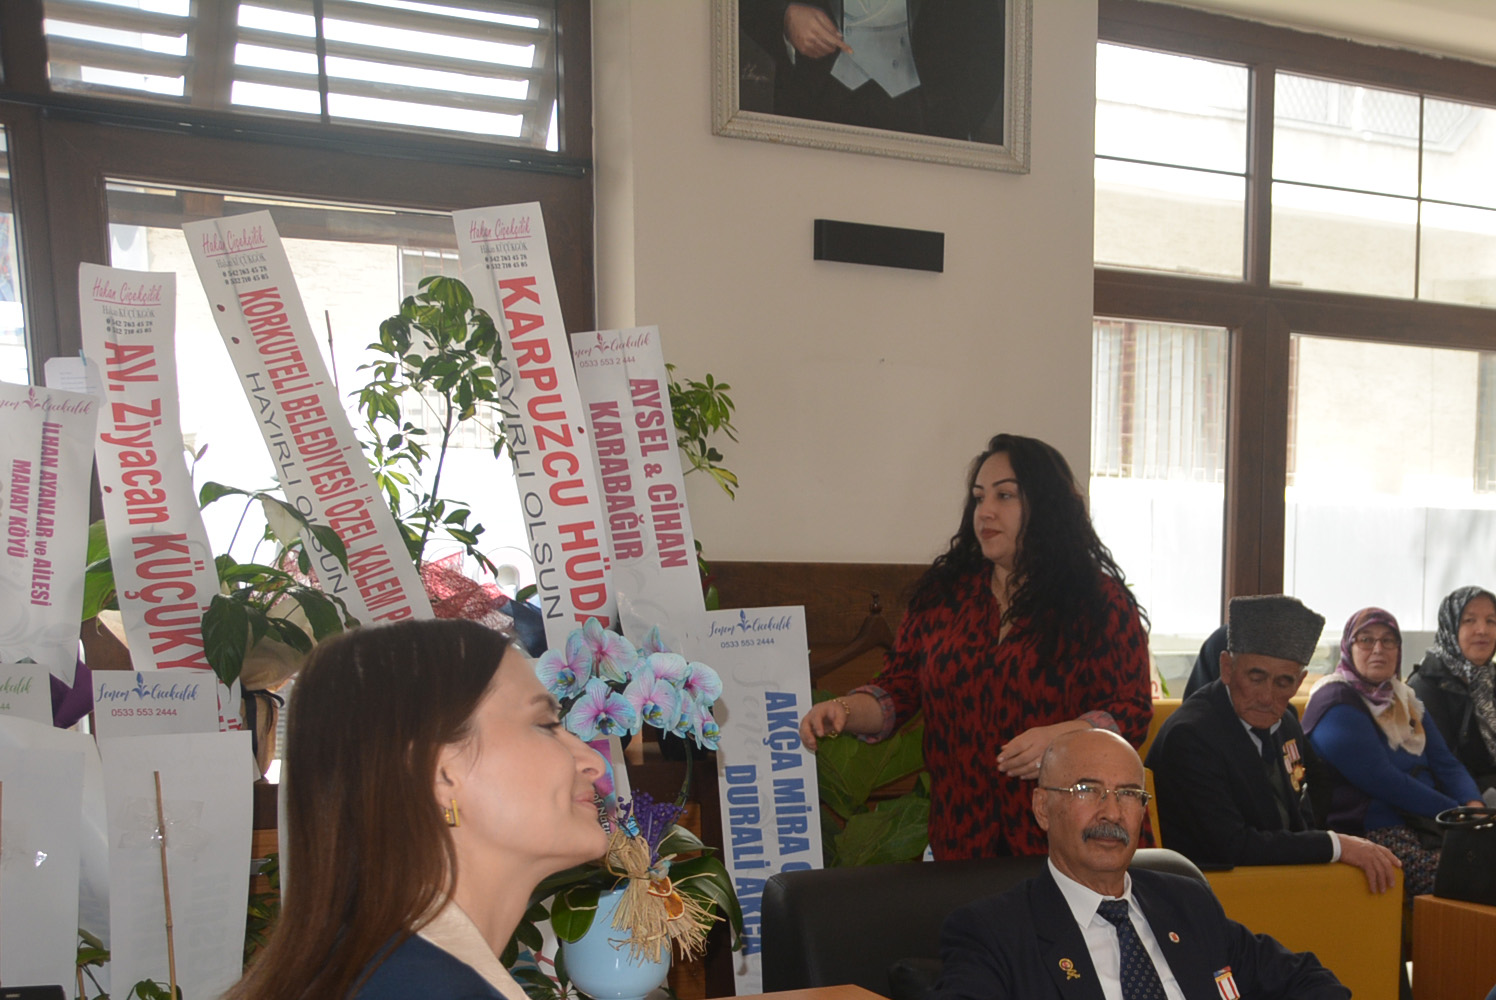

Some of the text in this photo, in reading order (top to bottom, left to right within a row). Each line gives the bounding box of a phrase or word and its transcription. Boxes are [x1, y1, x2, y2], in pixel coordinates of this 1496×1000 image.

[238, 286, 323, 395] KORKUTELİ
[498, 276, 589, 507] KARPUZCU
[580, 358, 598, 368] 0533
[600, 358, 614, 367] 553
[246, 372, 302, 486] HAYIRLI
[282, 394, 368, 502] BELEDİYESİ
[588, 401, 644, 560] KARABAĞIR
[629, 378, 688, 568] AYSEL & CİHAN
[6, 459, 32, 558] MANAY KÖYÜ
[30, 422, 62, 606] İLHAN AYANLAR ve AİLESİ
[100, 341, 214, 671] AV. Ziyacan KÜÇÜKY
[324, 494, 377, 549] ÖZEL
[524, 492, 564, 619] OLSUN
[346, 544, 404, 612] KALEM
[720, 638, 775, 649] 0533 553 2444
[111, 708, 177, 717] 0533 553 2444
[762, 691, 804, 771] AKÇA
[725, 764, 771, 870] DURALİ
[772, 777, 812, 856] MİRA
